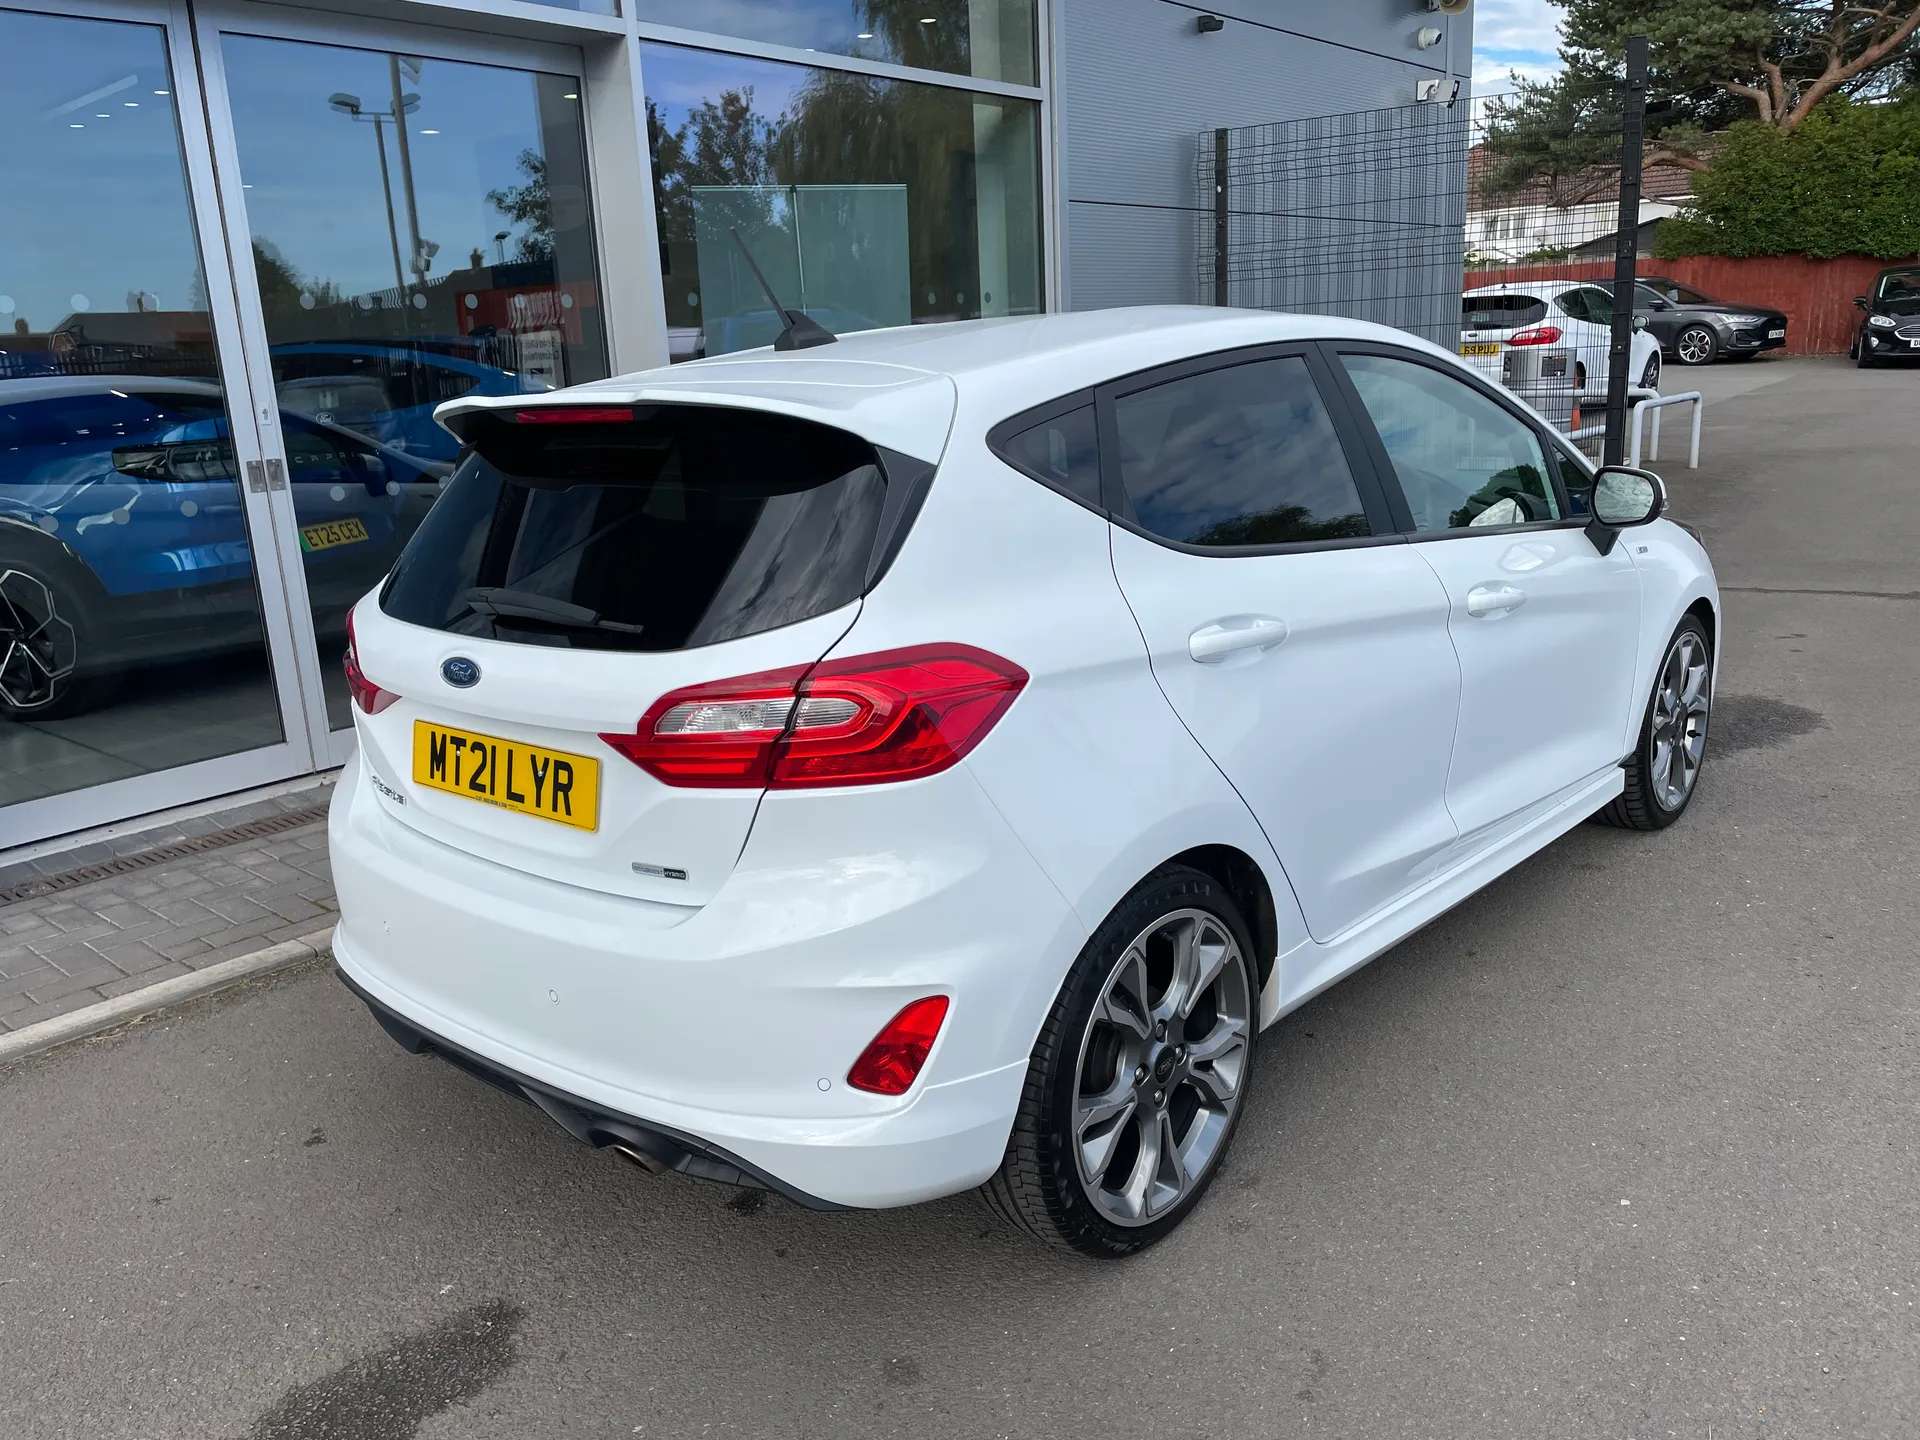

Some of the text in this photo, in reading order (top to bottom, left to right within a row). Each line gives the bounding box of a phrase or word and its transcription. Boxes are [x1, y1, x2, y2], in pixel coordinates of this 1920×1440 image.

[303, 520, 366, 548] ET25 CEX
[429, 731, 574, 816] MT21 LYR
